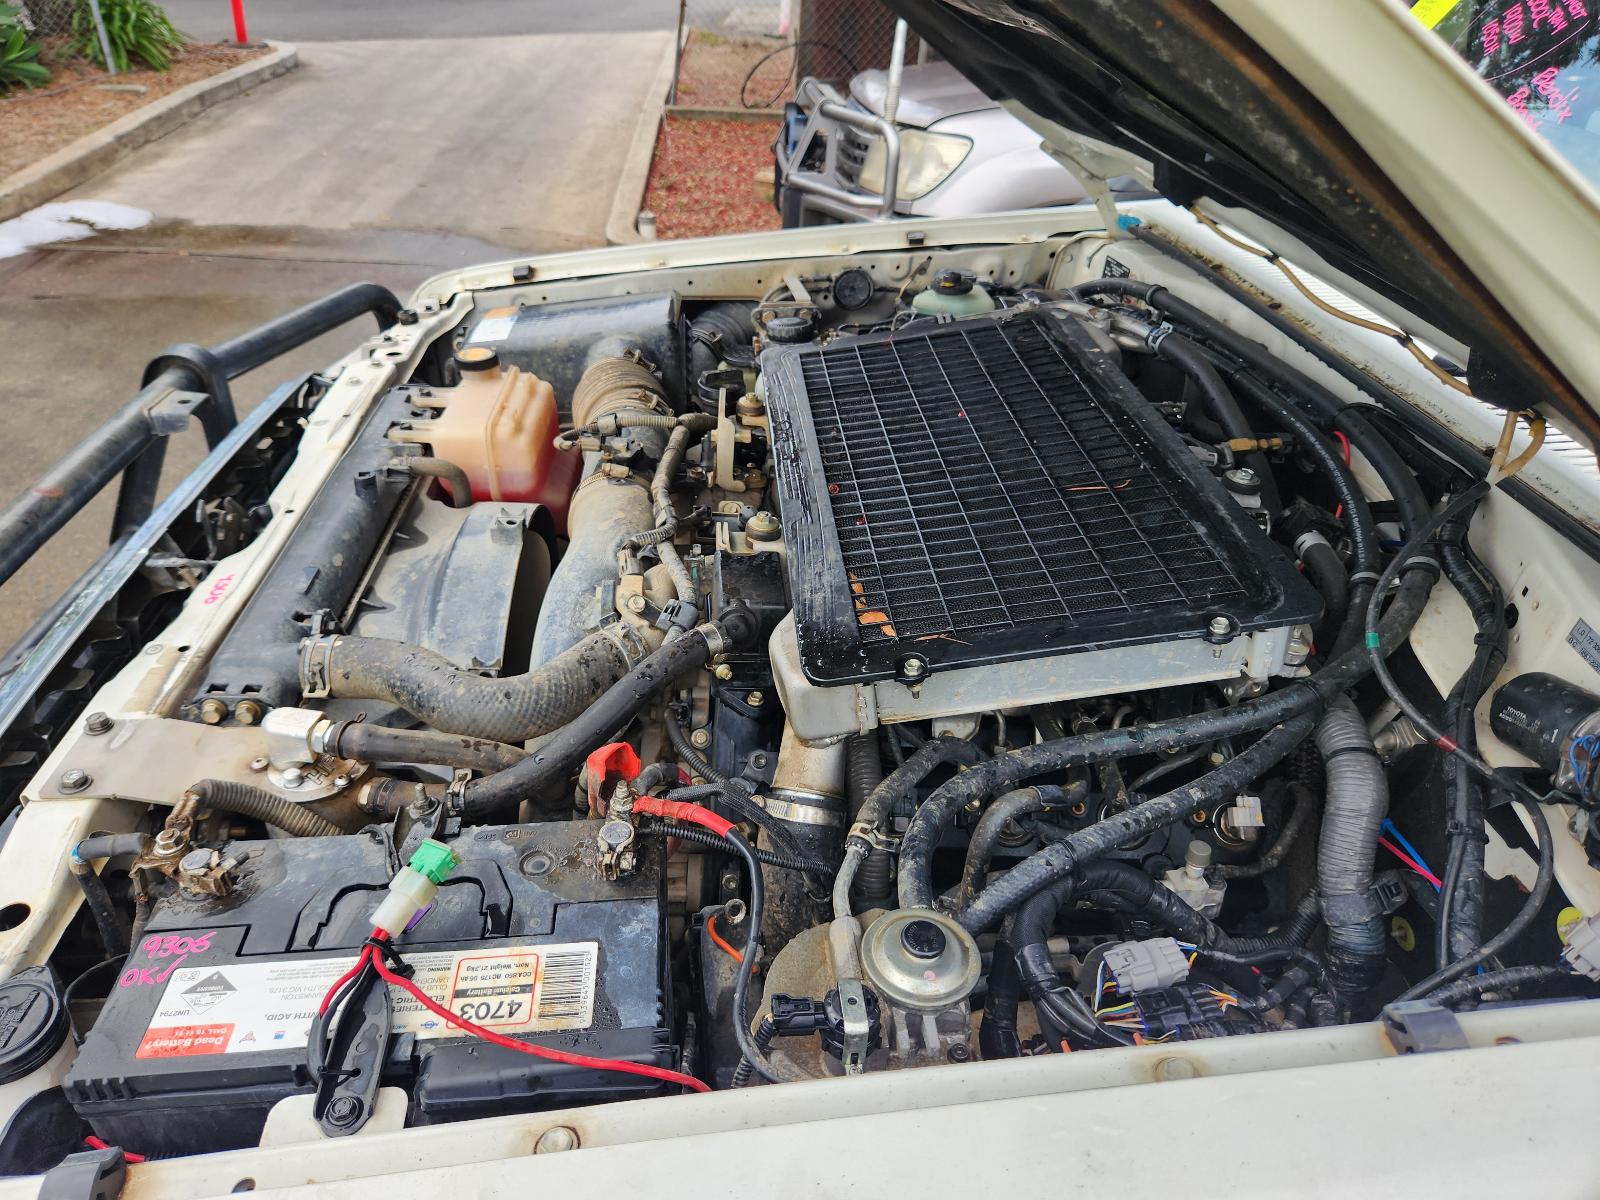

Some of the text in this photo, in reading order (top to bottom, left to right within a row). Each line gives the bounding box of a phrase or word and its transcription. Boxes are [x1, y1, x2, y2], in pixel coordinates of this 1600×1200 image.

[1532, 66, 1580, 124] Bendix
[1507, 706, 1527, 720] TOYOTA
[143, 931, 217, 959] 9306
[120, 966, 160, 987] OK
[466, 985, 521, 997] Calcium Battery
[159, 1009, 190, 1018] UN2794
[460, 999, 523, 1021] 4703
[145, 1036, 224, 1049] Dead Battery?
